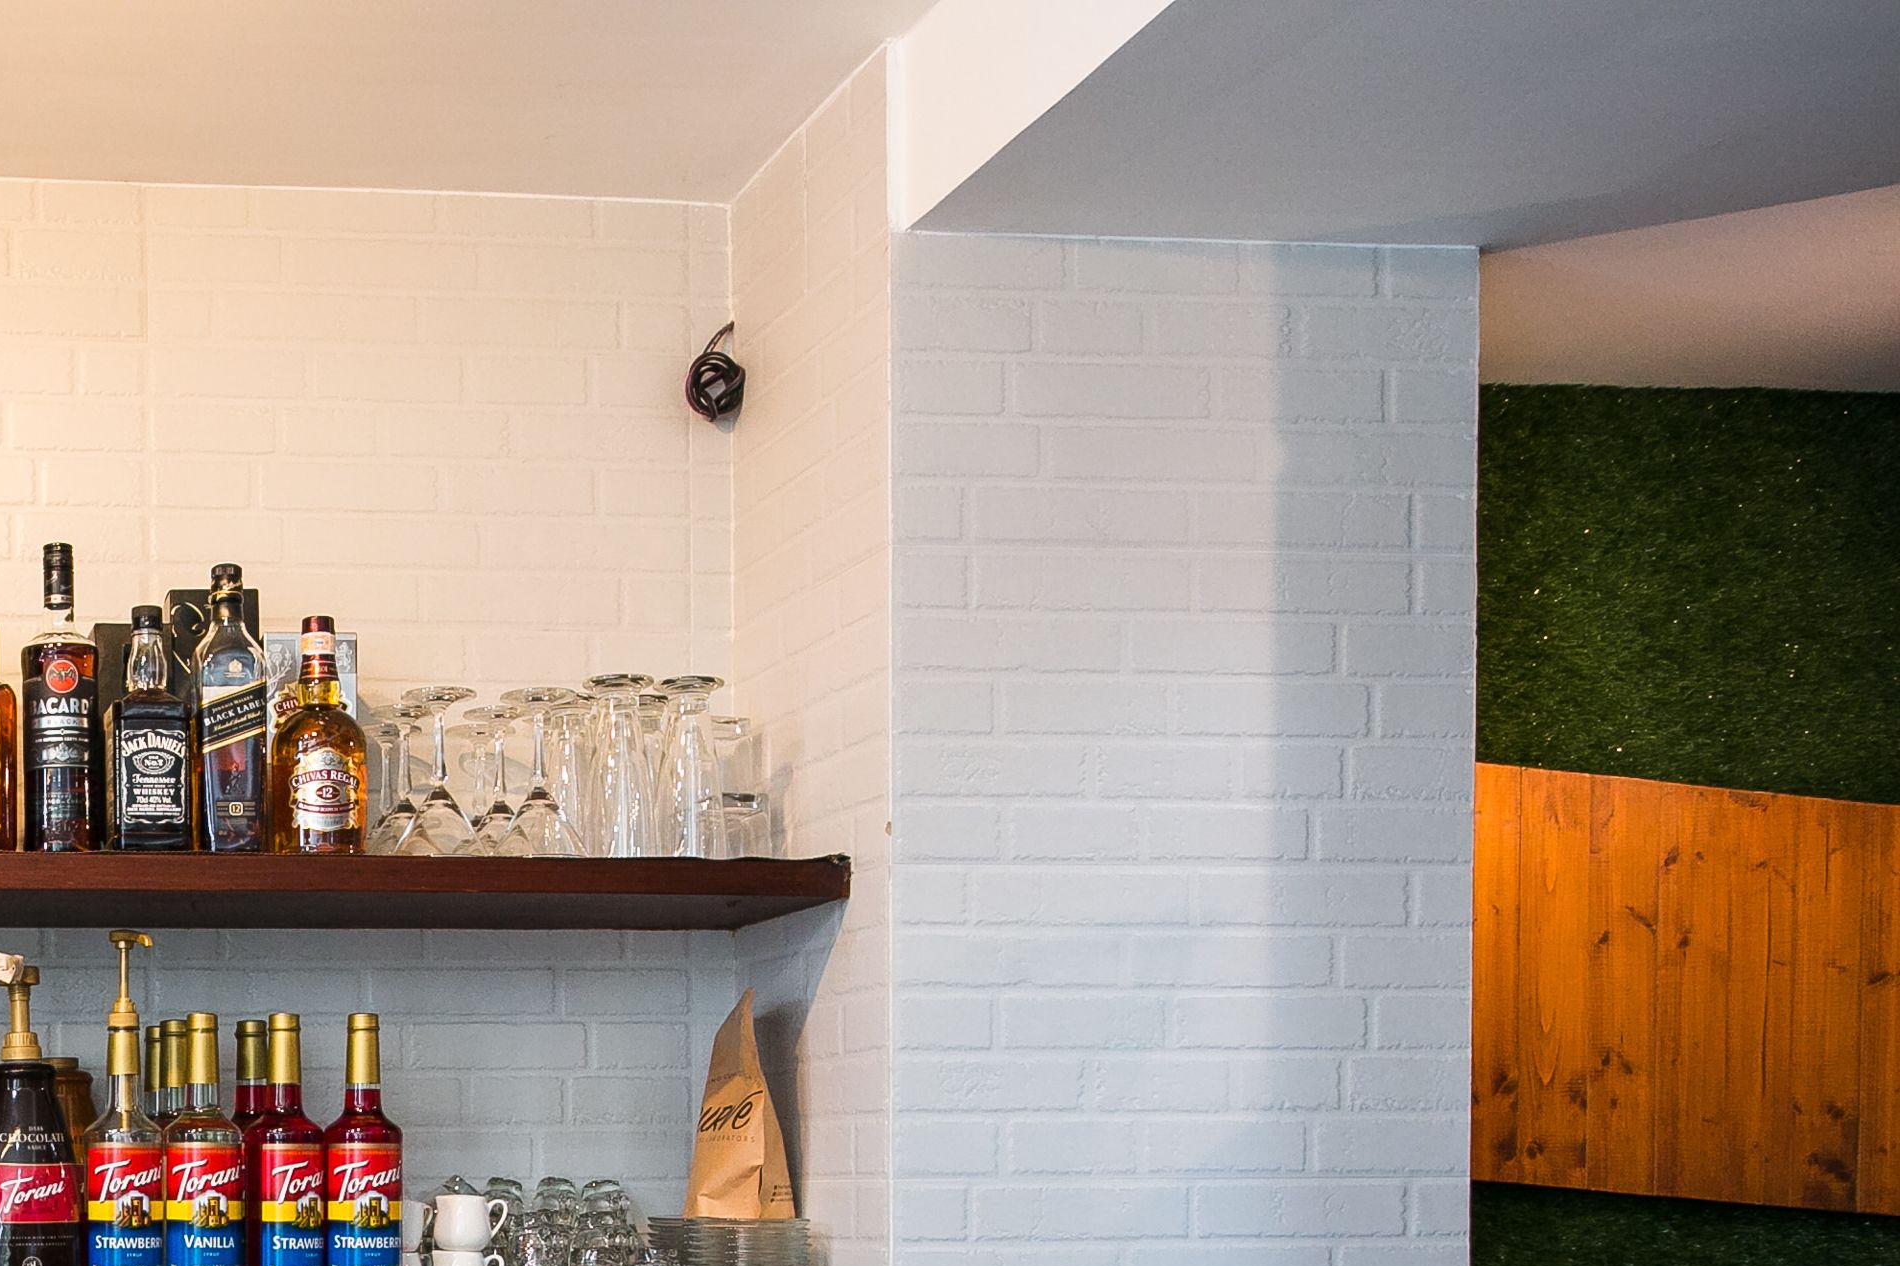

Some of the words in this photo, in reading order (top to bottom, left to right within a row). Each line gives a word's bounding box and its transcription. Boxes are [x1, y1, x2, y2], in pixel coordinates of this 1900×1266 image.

[32, 696, 93, 715] BACARD
[204, 710, 236, 727] BLACK
[237, 698, 265, 715] LABEL
[275, 700, 298, 713] CHIV
[121, 736, 147, 757] JACK
[147, 732, 186, 758] DANIEL'S
[144, 759, 164, 767] No.7
[132, 773, 176, 784] Tennessee
[292, 771, 328, 787] CHIVAS
[330, 770, 357, 786] REGAL
[133, 788, 175, 796] WHISKEY
[322, 787, 333, 798] 12
[231, 805, 242, 813] 12
[94, 1159, 162, 1203] Torani
[172, 1159, 240, 1203] Torani
[333, 1160, 402, 1203] Torani
[0, 1176, 66, 1214] Torani
[184, 1234, 235, 1248] VANILLA
[273, 1235, 324, 1249] STRAWBE
[334, 1235, 401, 1249] STRAWBERR
